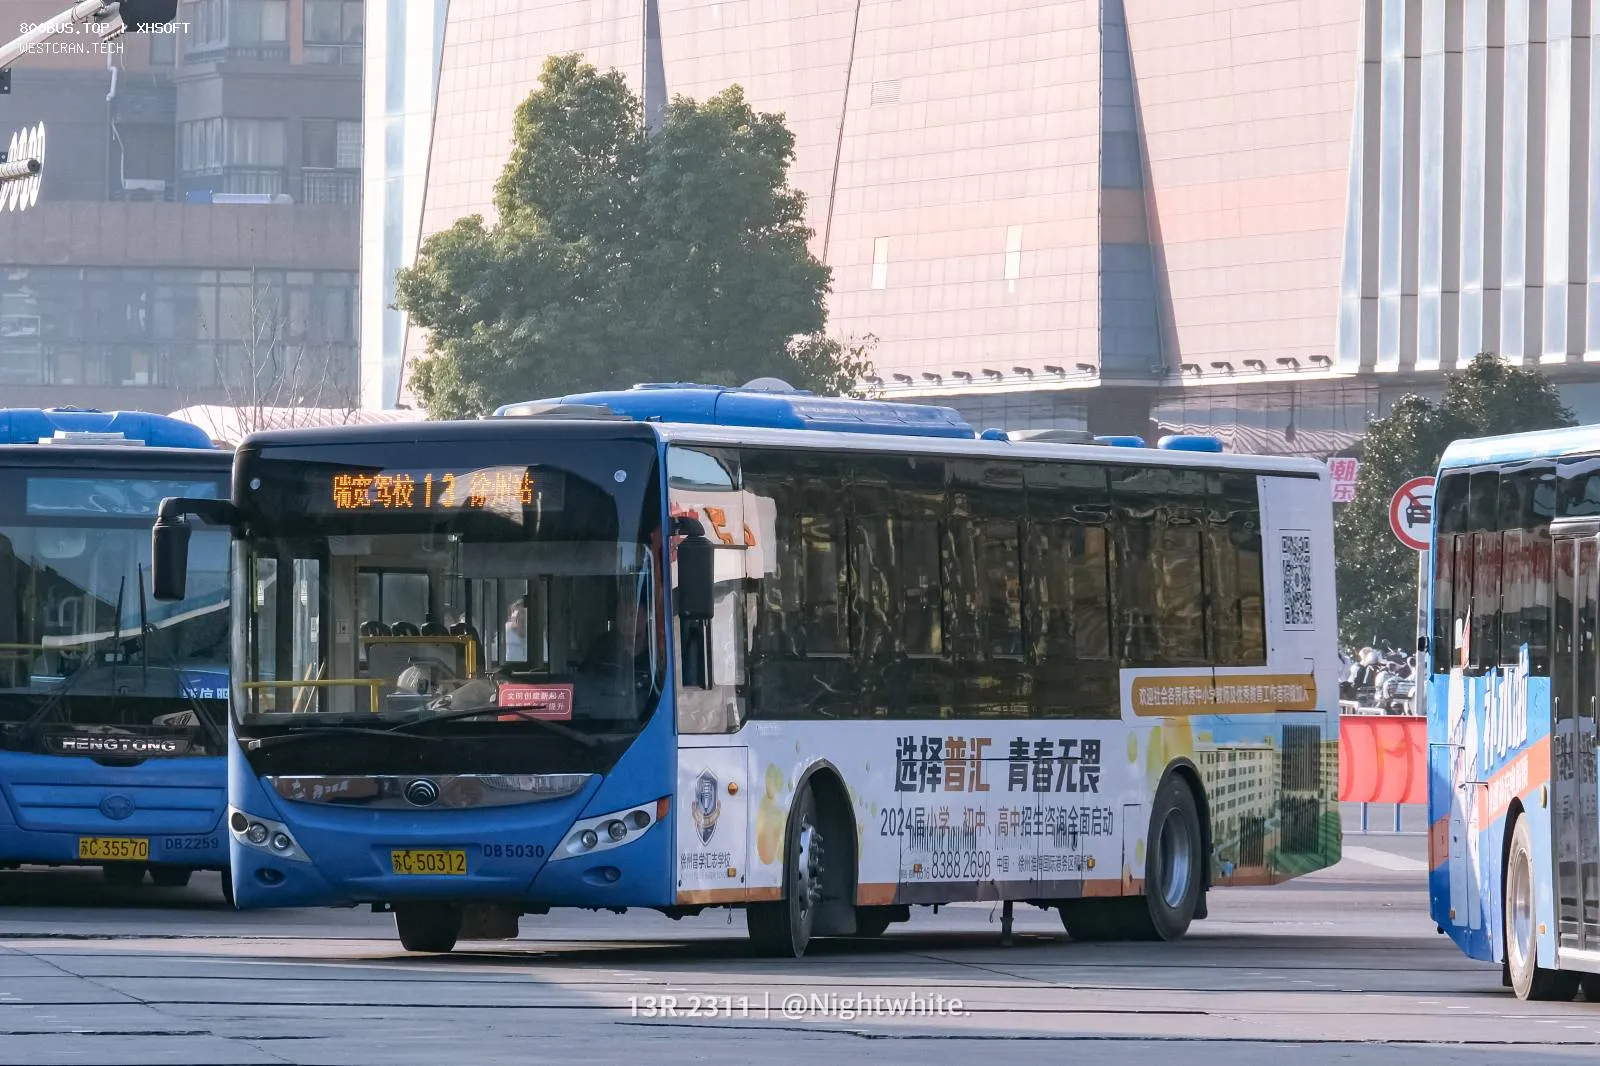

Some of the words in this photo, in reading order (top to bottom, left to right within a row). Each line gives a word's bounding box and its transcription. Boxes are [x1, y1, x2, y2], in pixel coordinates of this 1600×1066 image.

[62, 737, 176, 753] HENGTONG
[894, 735, 992, 793] 选择普汇
[1008, 736, 1102, 793] 青春无畏
